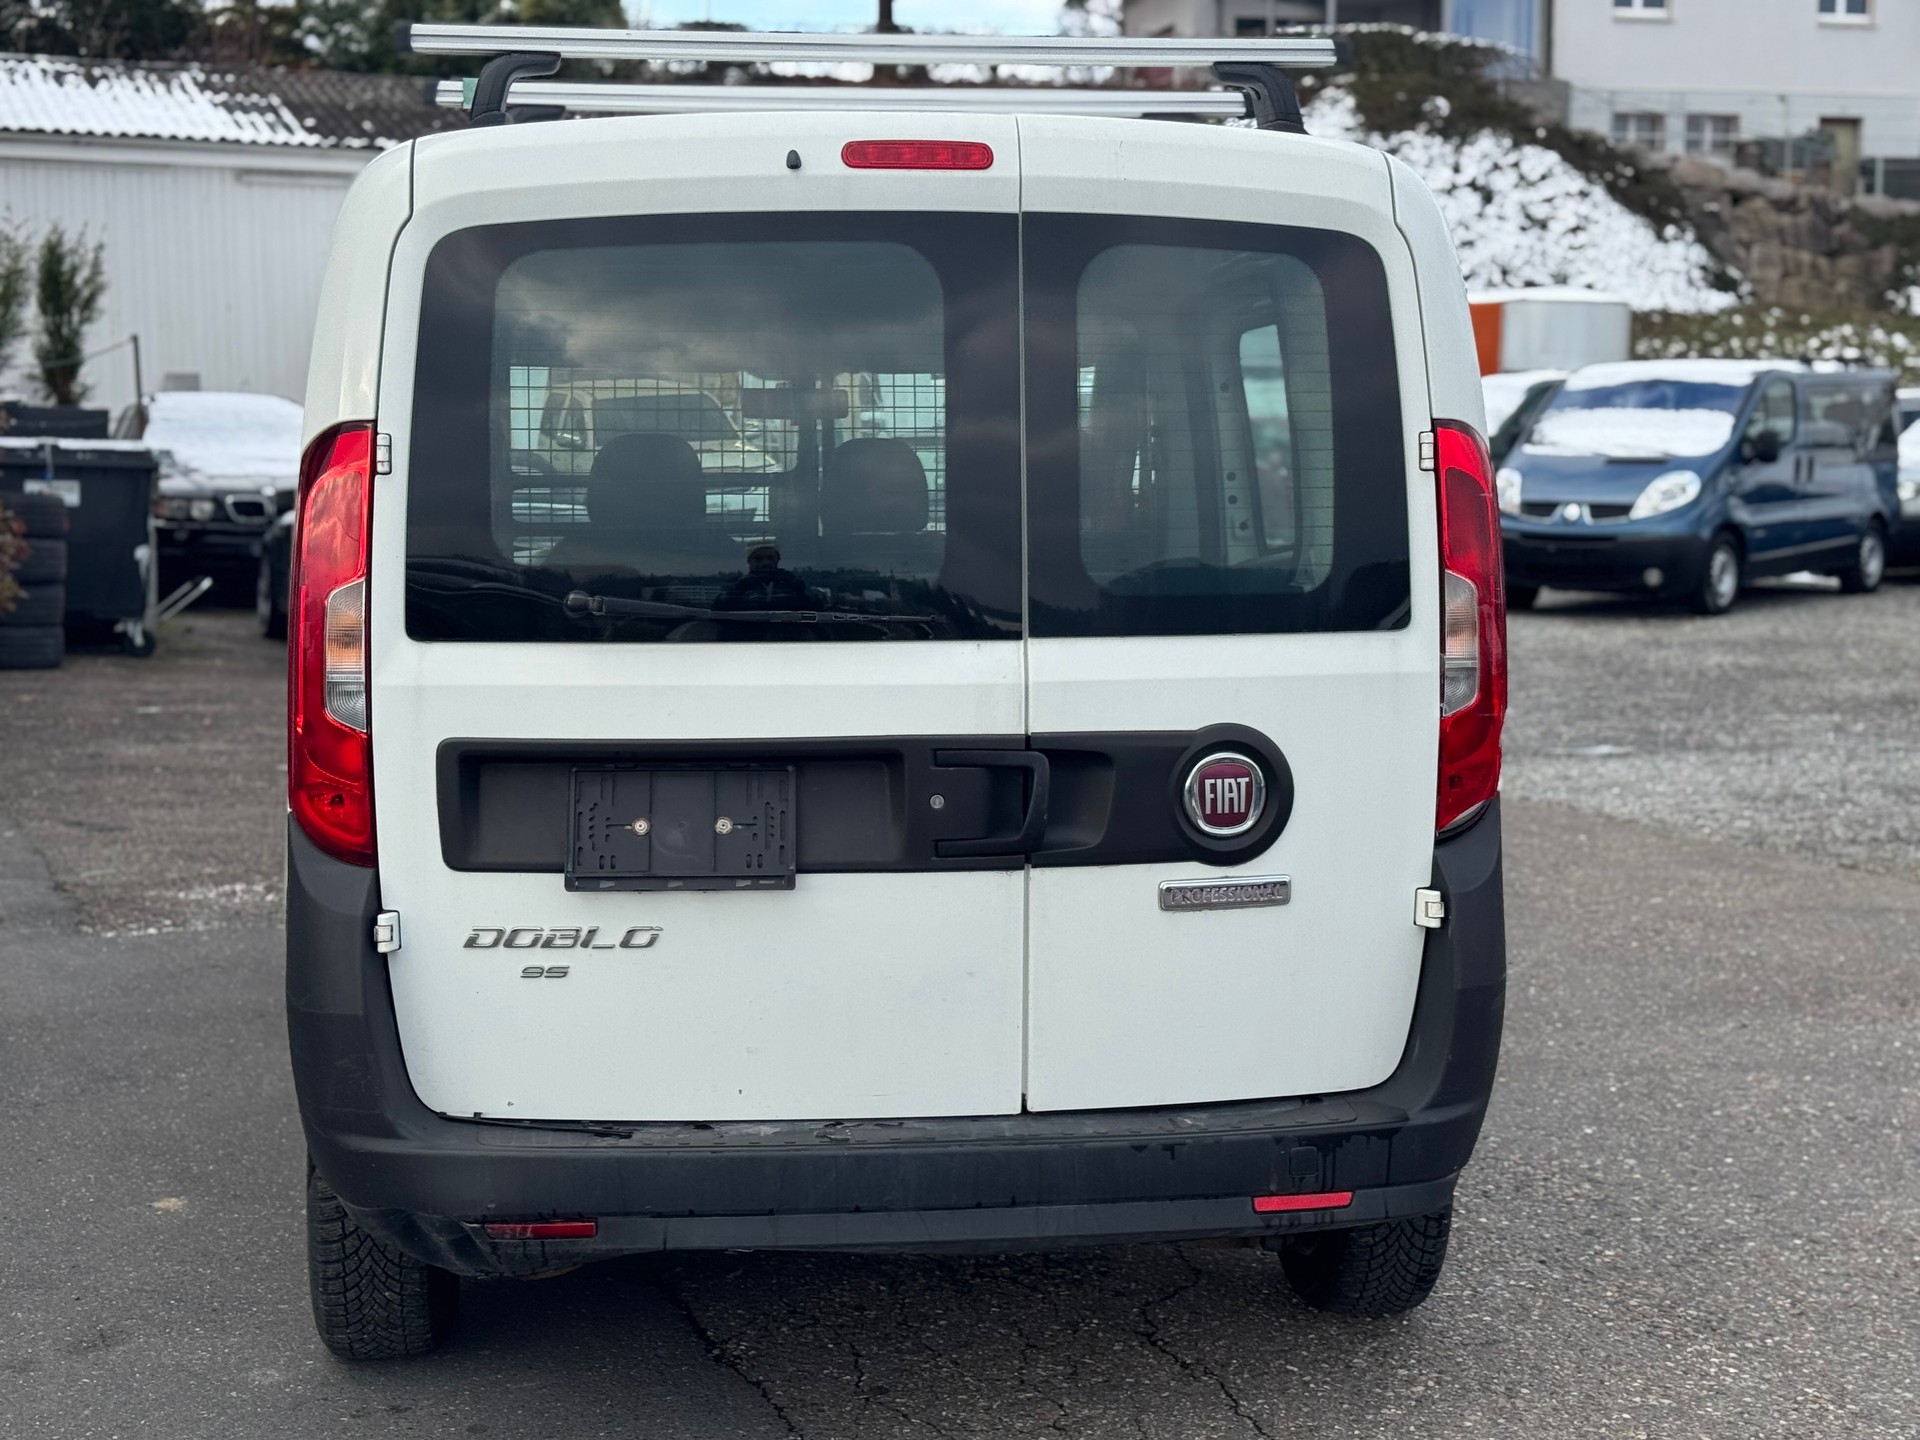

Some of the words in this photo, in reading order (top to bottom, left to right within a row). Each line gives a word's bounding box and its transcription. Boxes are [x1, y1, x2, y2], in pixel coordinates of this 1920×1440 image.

[1204, 777, 1250, 815] FIAT
[1170, 883, 1284, 905] PROFESSIONAL
[520, 964, 571, 979] 95
